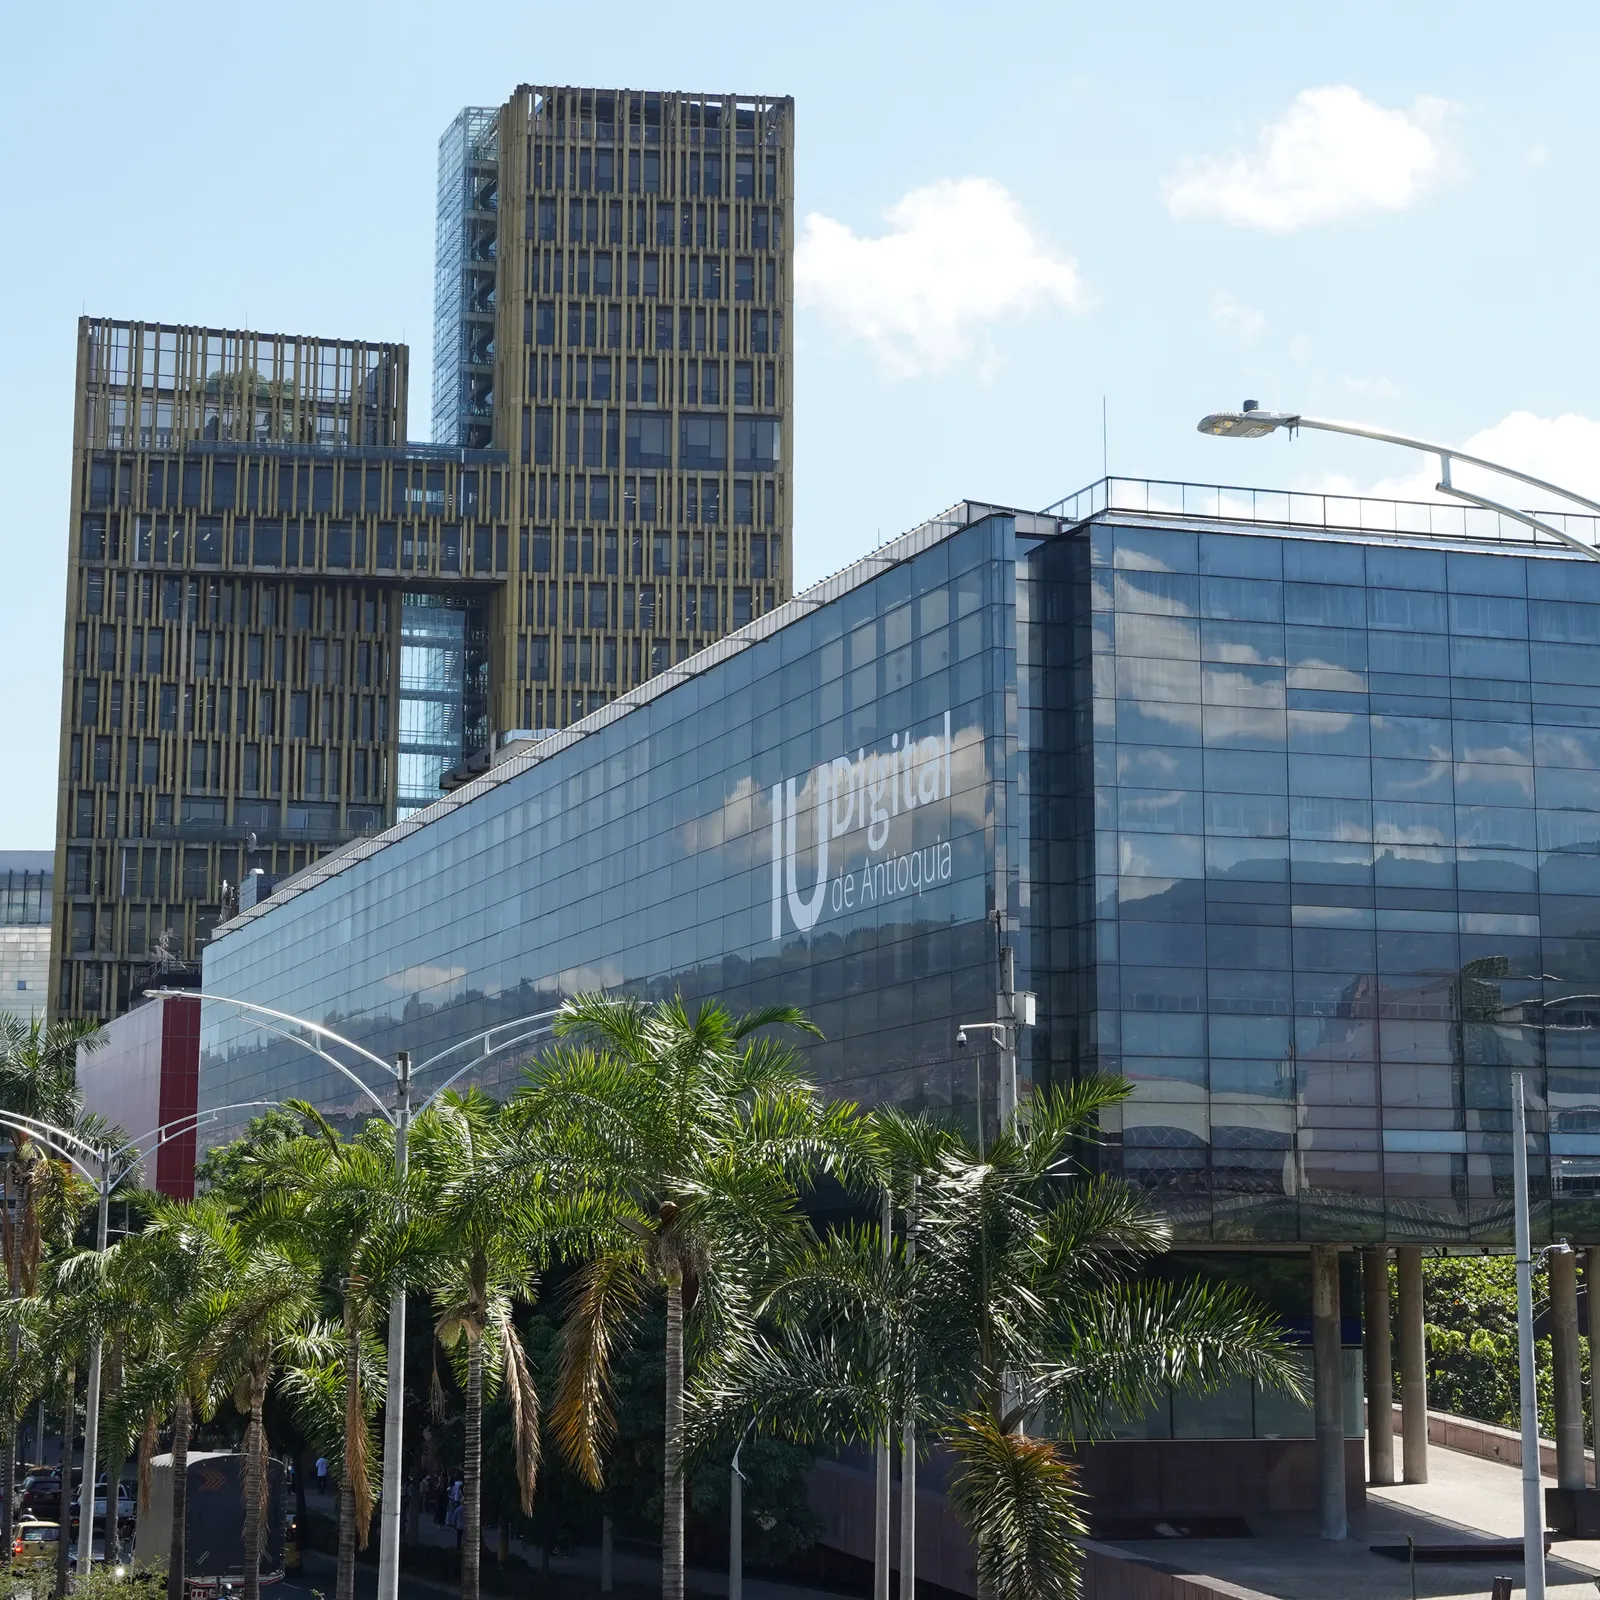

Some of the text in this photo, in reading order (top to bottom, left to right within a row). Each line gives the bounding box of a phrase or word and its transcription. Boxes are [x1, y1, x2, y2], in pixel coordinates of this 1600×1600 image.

[772, 710, 950, 940] IU Digital
[832, 835, 951, 912] de Antioquia
